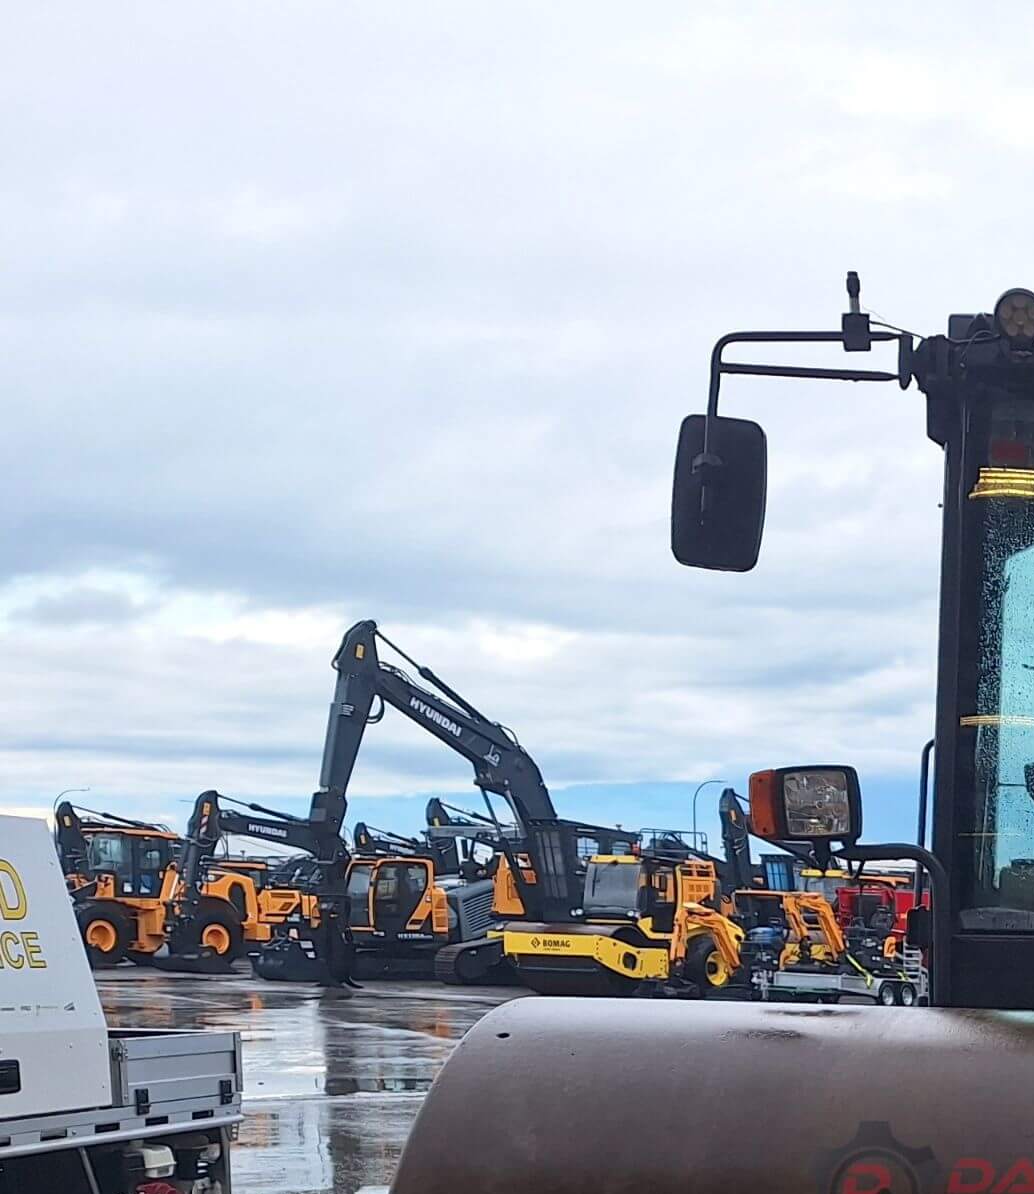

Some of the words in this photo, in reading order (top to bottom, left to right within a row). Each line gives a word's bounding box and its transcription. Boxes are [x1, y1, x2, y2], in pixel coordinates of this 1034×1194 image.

[409, 696, 463, 737] HYUNDAI
[248, 823, 288, 838] HYUNDAI
[543, 939, 571, 948] BOMAG
